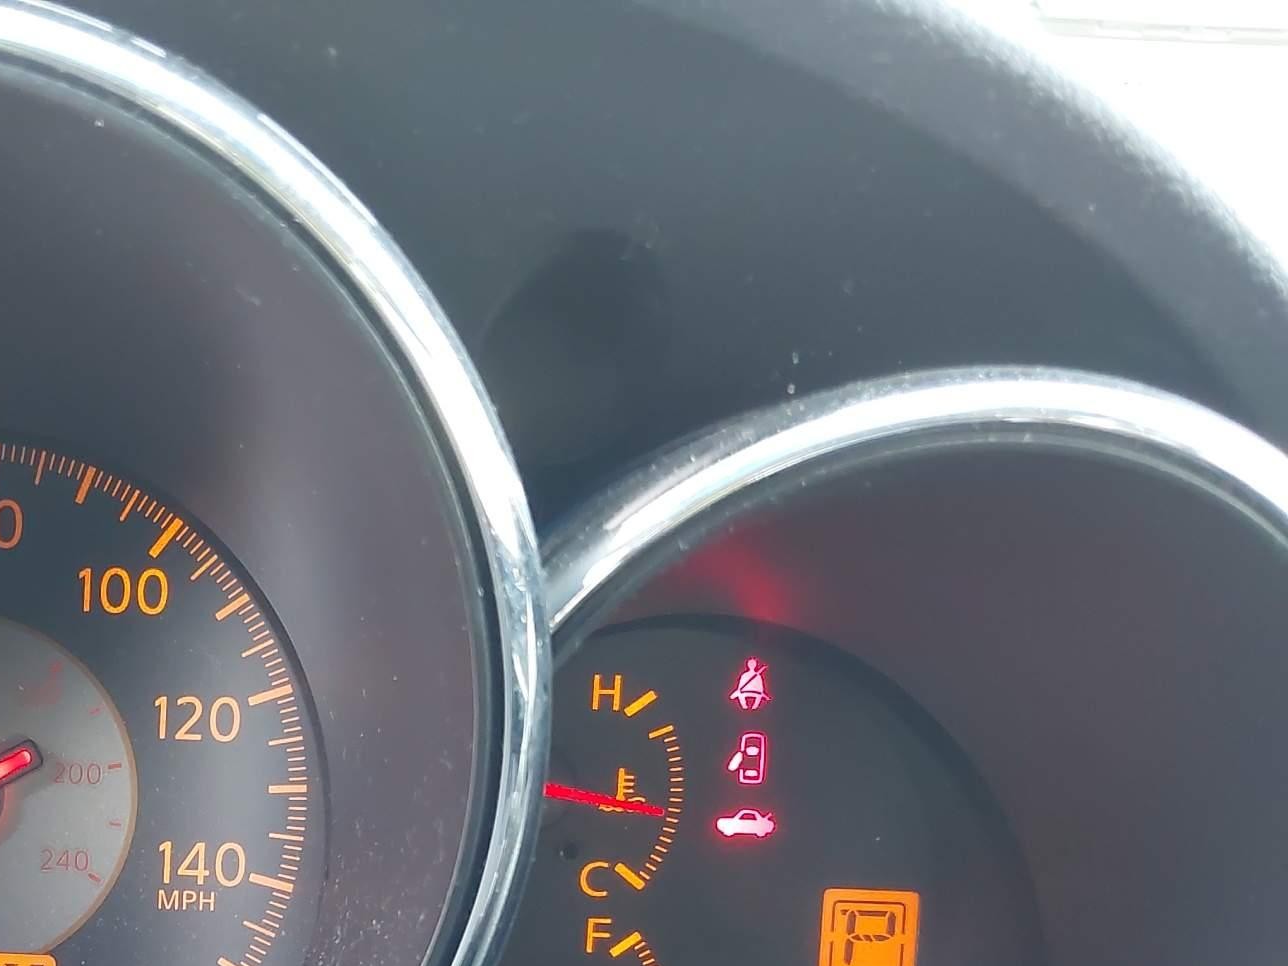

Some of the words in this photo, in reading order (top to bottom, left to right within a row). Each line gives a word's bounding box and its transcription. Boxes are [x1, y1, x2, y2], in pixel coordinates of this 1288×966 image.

[77, 567, 169, 615] 100
[592, 674, 623, 711] H
[154, 695, 242, 743] 120
[54, 762, 102, 785] 200
[39, 847, 89, 872] 240
[158, 841, 247, 888] 140
[579, 862, 610, 898] C
[157, 890, 215, 913] MPH
[585, 918, 613, 954] F
